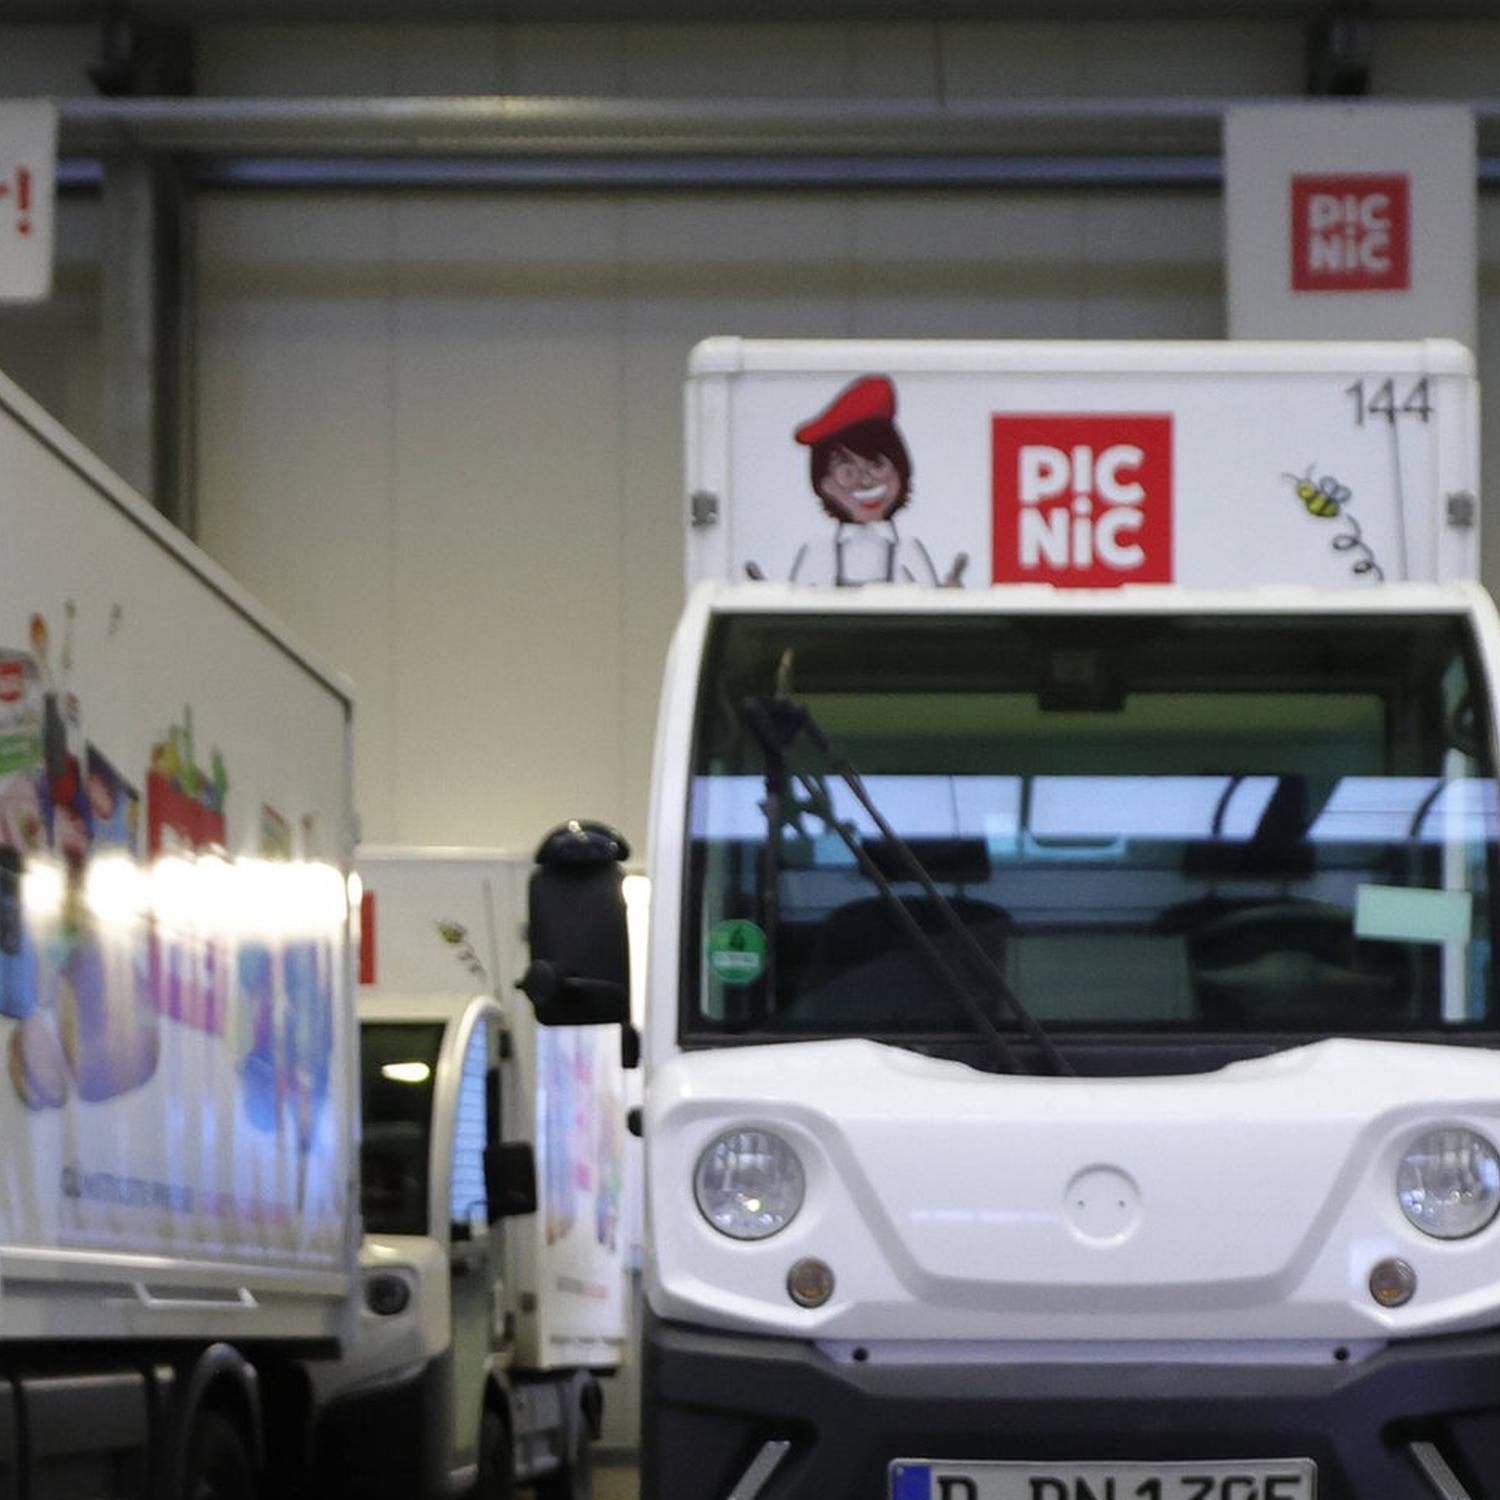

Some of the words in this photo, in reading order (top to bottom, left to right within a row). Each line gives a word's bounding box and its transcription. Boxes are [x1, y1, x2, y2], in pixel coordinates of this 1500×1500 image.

[1309, 193, 1391, 230] PIC
[1345, 377, 1436, 427] 144
[1017, 444, 1146, 504] PIC
